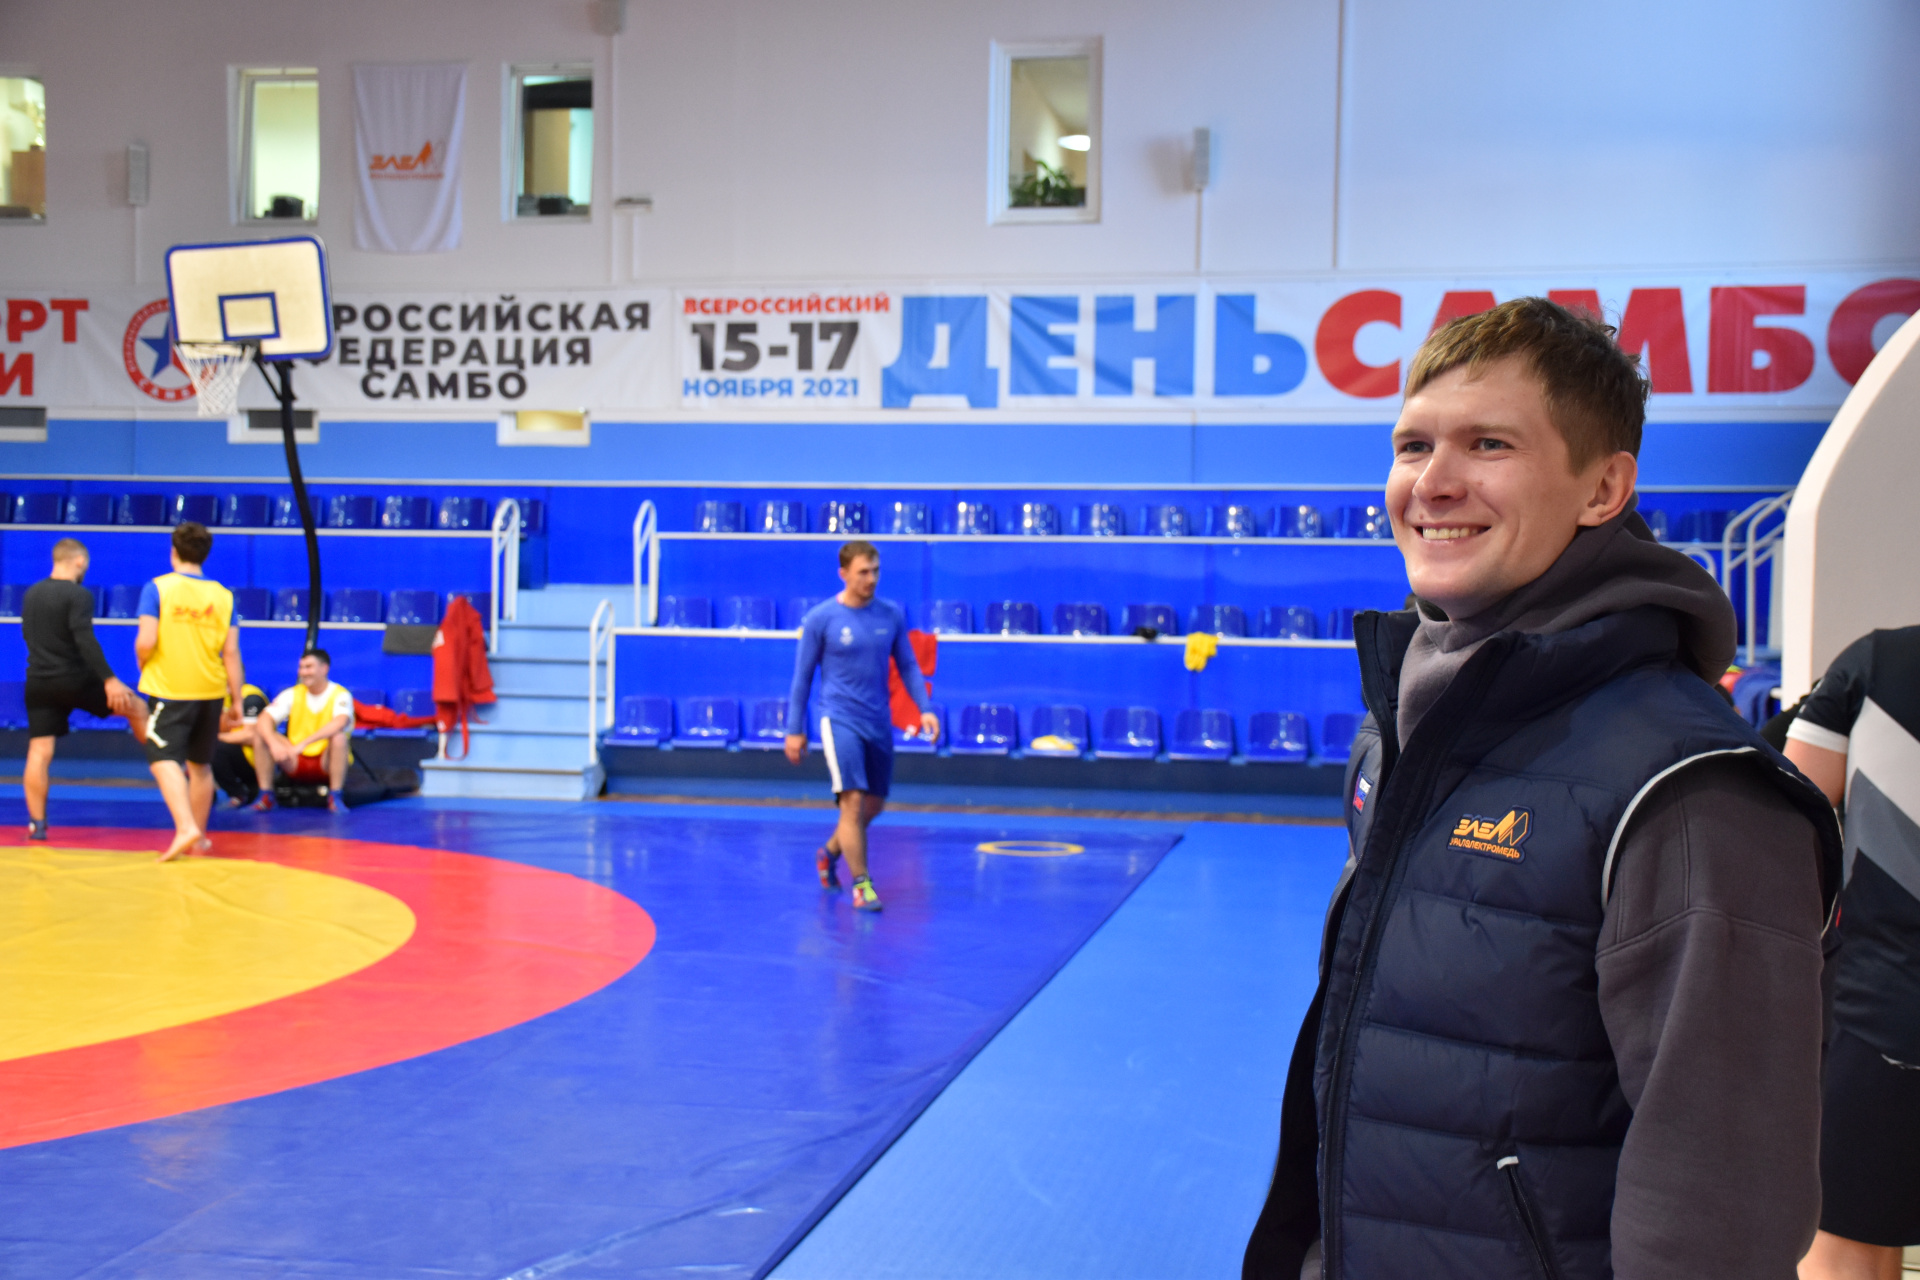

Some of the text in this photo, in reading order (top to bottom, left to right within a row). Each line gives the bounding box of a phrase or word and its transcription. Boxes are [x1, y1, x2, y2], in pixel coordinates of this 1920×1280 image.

[684, 293, 890, 314] ВСЕРОССИЙСКИЙ
[0, 298, 89, 343] РТ
[691, 321, 859, 372] 15-17
[881, 278, 1920, 409] ДЕНЬ СМБО
[361, 370, 527, 400] САМБО
[683, 378, 859, 397] НОЯБРЯ 2021
[1449, 837, 1520, 859] УРАЛЭЛЕКТРОМЕДЬ
